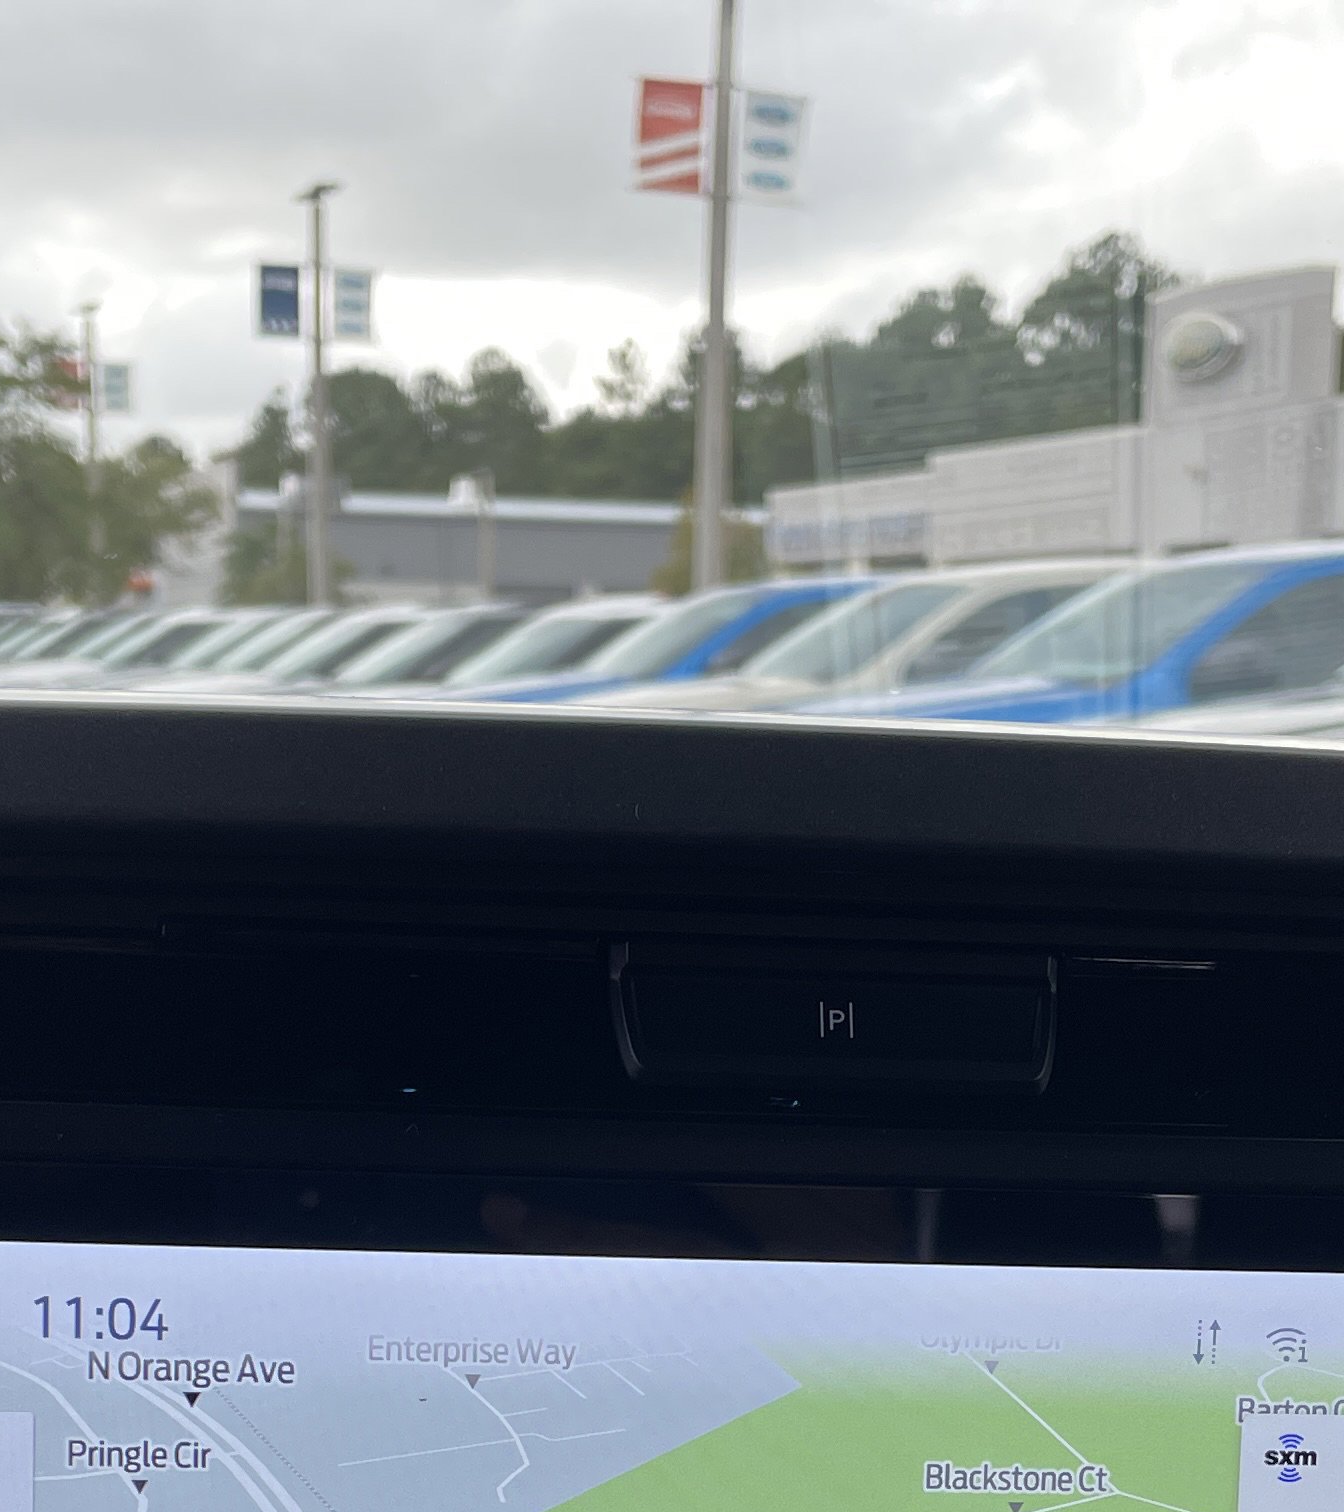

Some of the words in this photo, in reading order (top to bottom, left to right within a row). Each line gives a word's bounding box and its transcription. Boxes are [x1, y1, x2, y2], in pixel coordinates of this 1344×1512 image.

[33, 1296, 168, 1340] 11:04
[87, 1352, 110, 1380] N
[117, 1351, 230, 1387] Orange
[236, 1356, 295, 1384] Ave
[368, 1335, 509, 1369] Enterprise
[517, 1339, 576, 1369] Way
[68, 1440, 168, 1478] Pringle
[174, 1442, 211, 1470] Cir
[1264, 1449, 1317, 1467] sxm
[925, 1464, 1073, 1491] Blackstone
[1078, 1466, 1108, 1492] Ct
